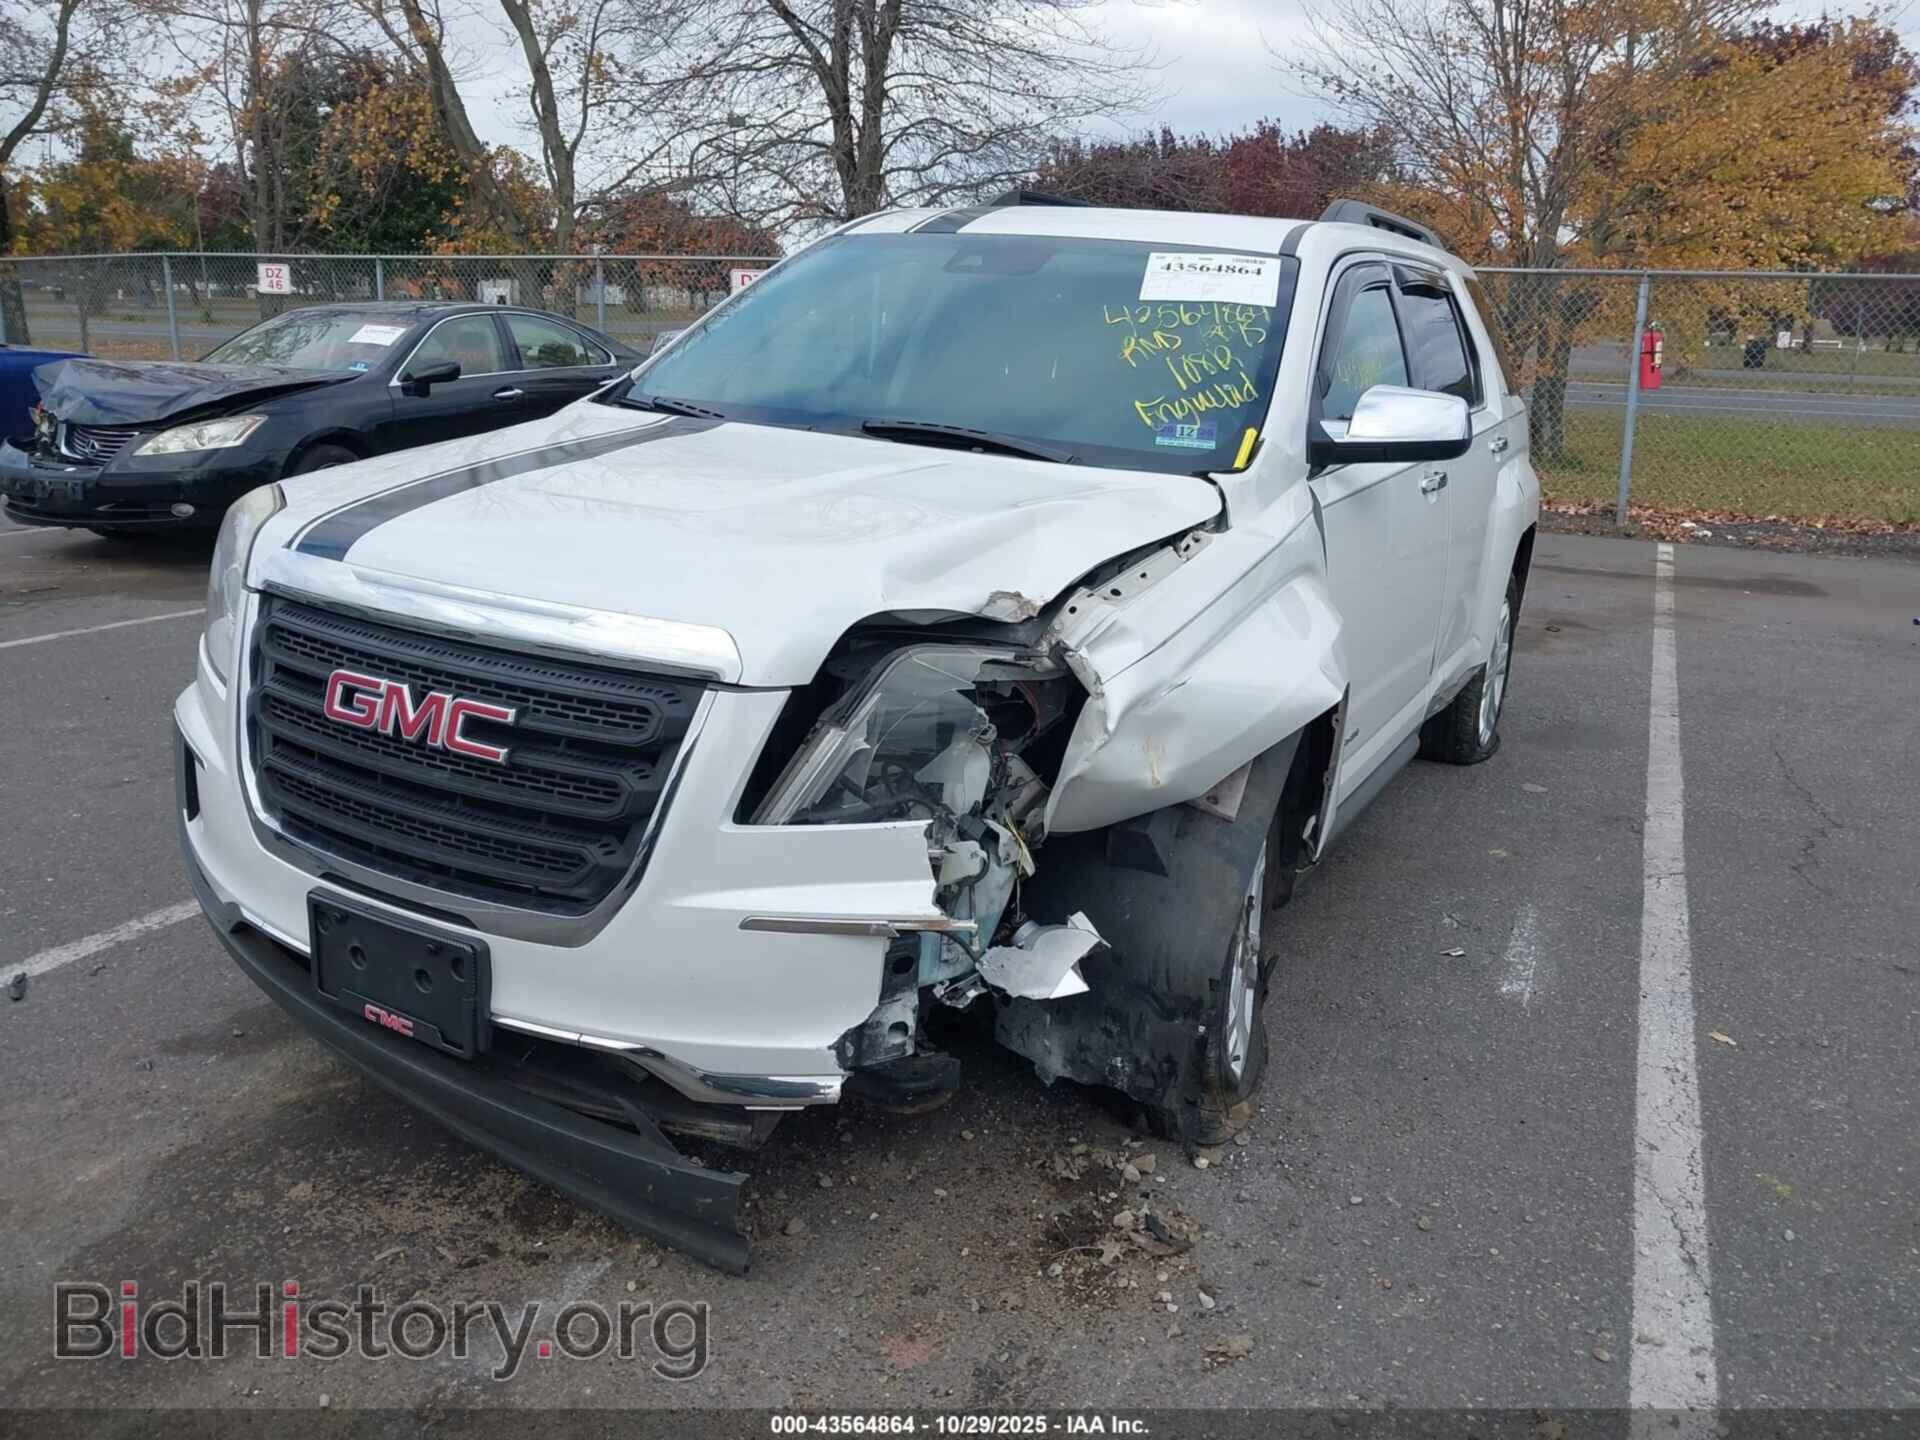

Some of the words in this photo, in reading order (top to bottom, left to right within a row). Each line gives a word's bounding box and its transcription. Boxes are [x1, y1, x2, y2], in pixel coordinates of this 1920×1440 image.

[265, 267, 283, 278] DZ
[1160, 262, 1262, 276] 43564864
[324, 669, 517, 764] GMC
[364, 1003, 415, 1038] GMC
